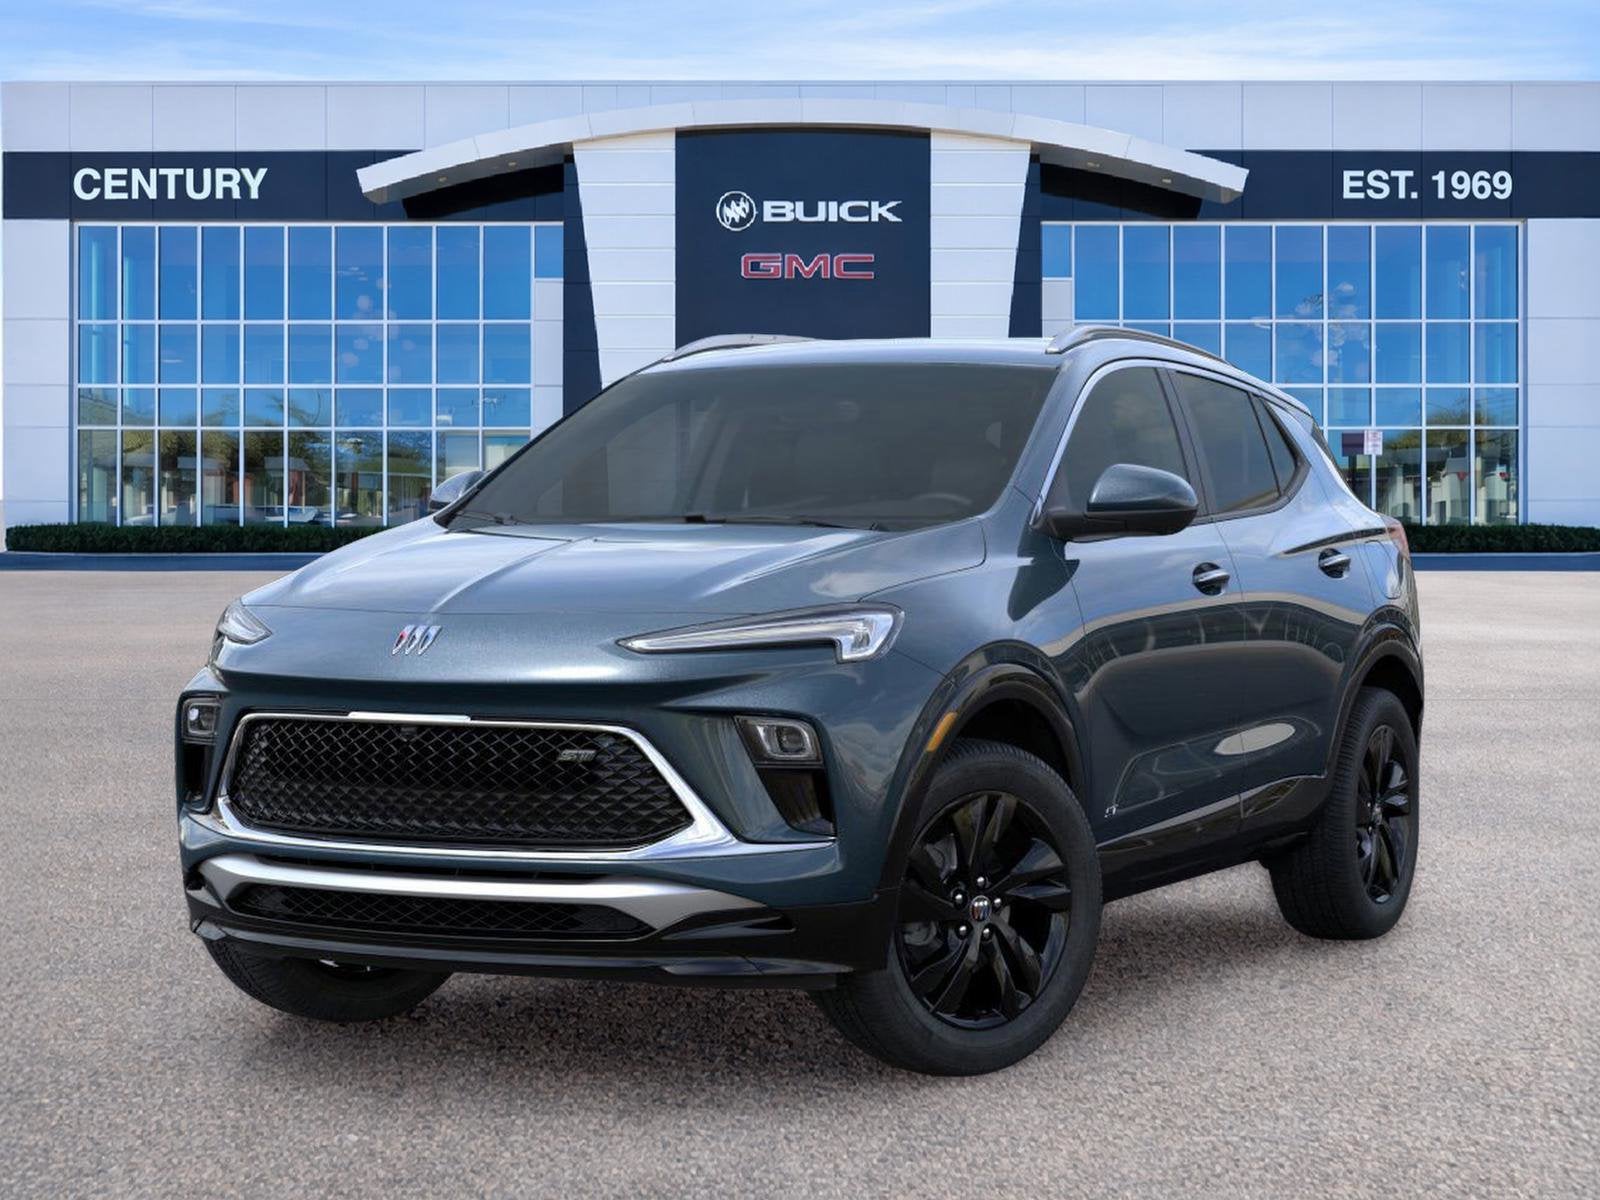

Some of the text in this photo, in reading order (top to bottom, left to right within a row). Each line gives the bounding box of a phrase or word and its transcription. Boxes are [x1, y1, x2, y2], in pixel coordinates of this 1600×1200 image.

[73, 167, 268, 200] CENTURY
[1342, 169, 1513, 200] EST. 1969
[763, 200, 902, 222] BUICK
[741, 253, 875, 279] GMC
